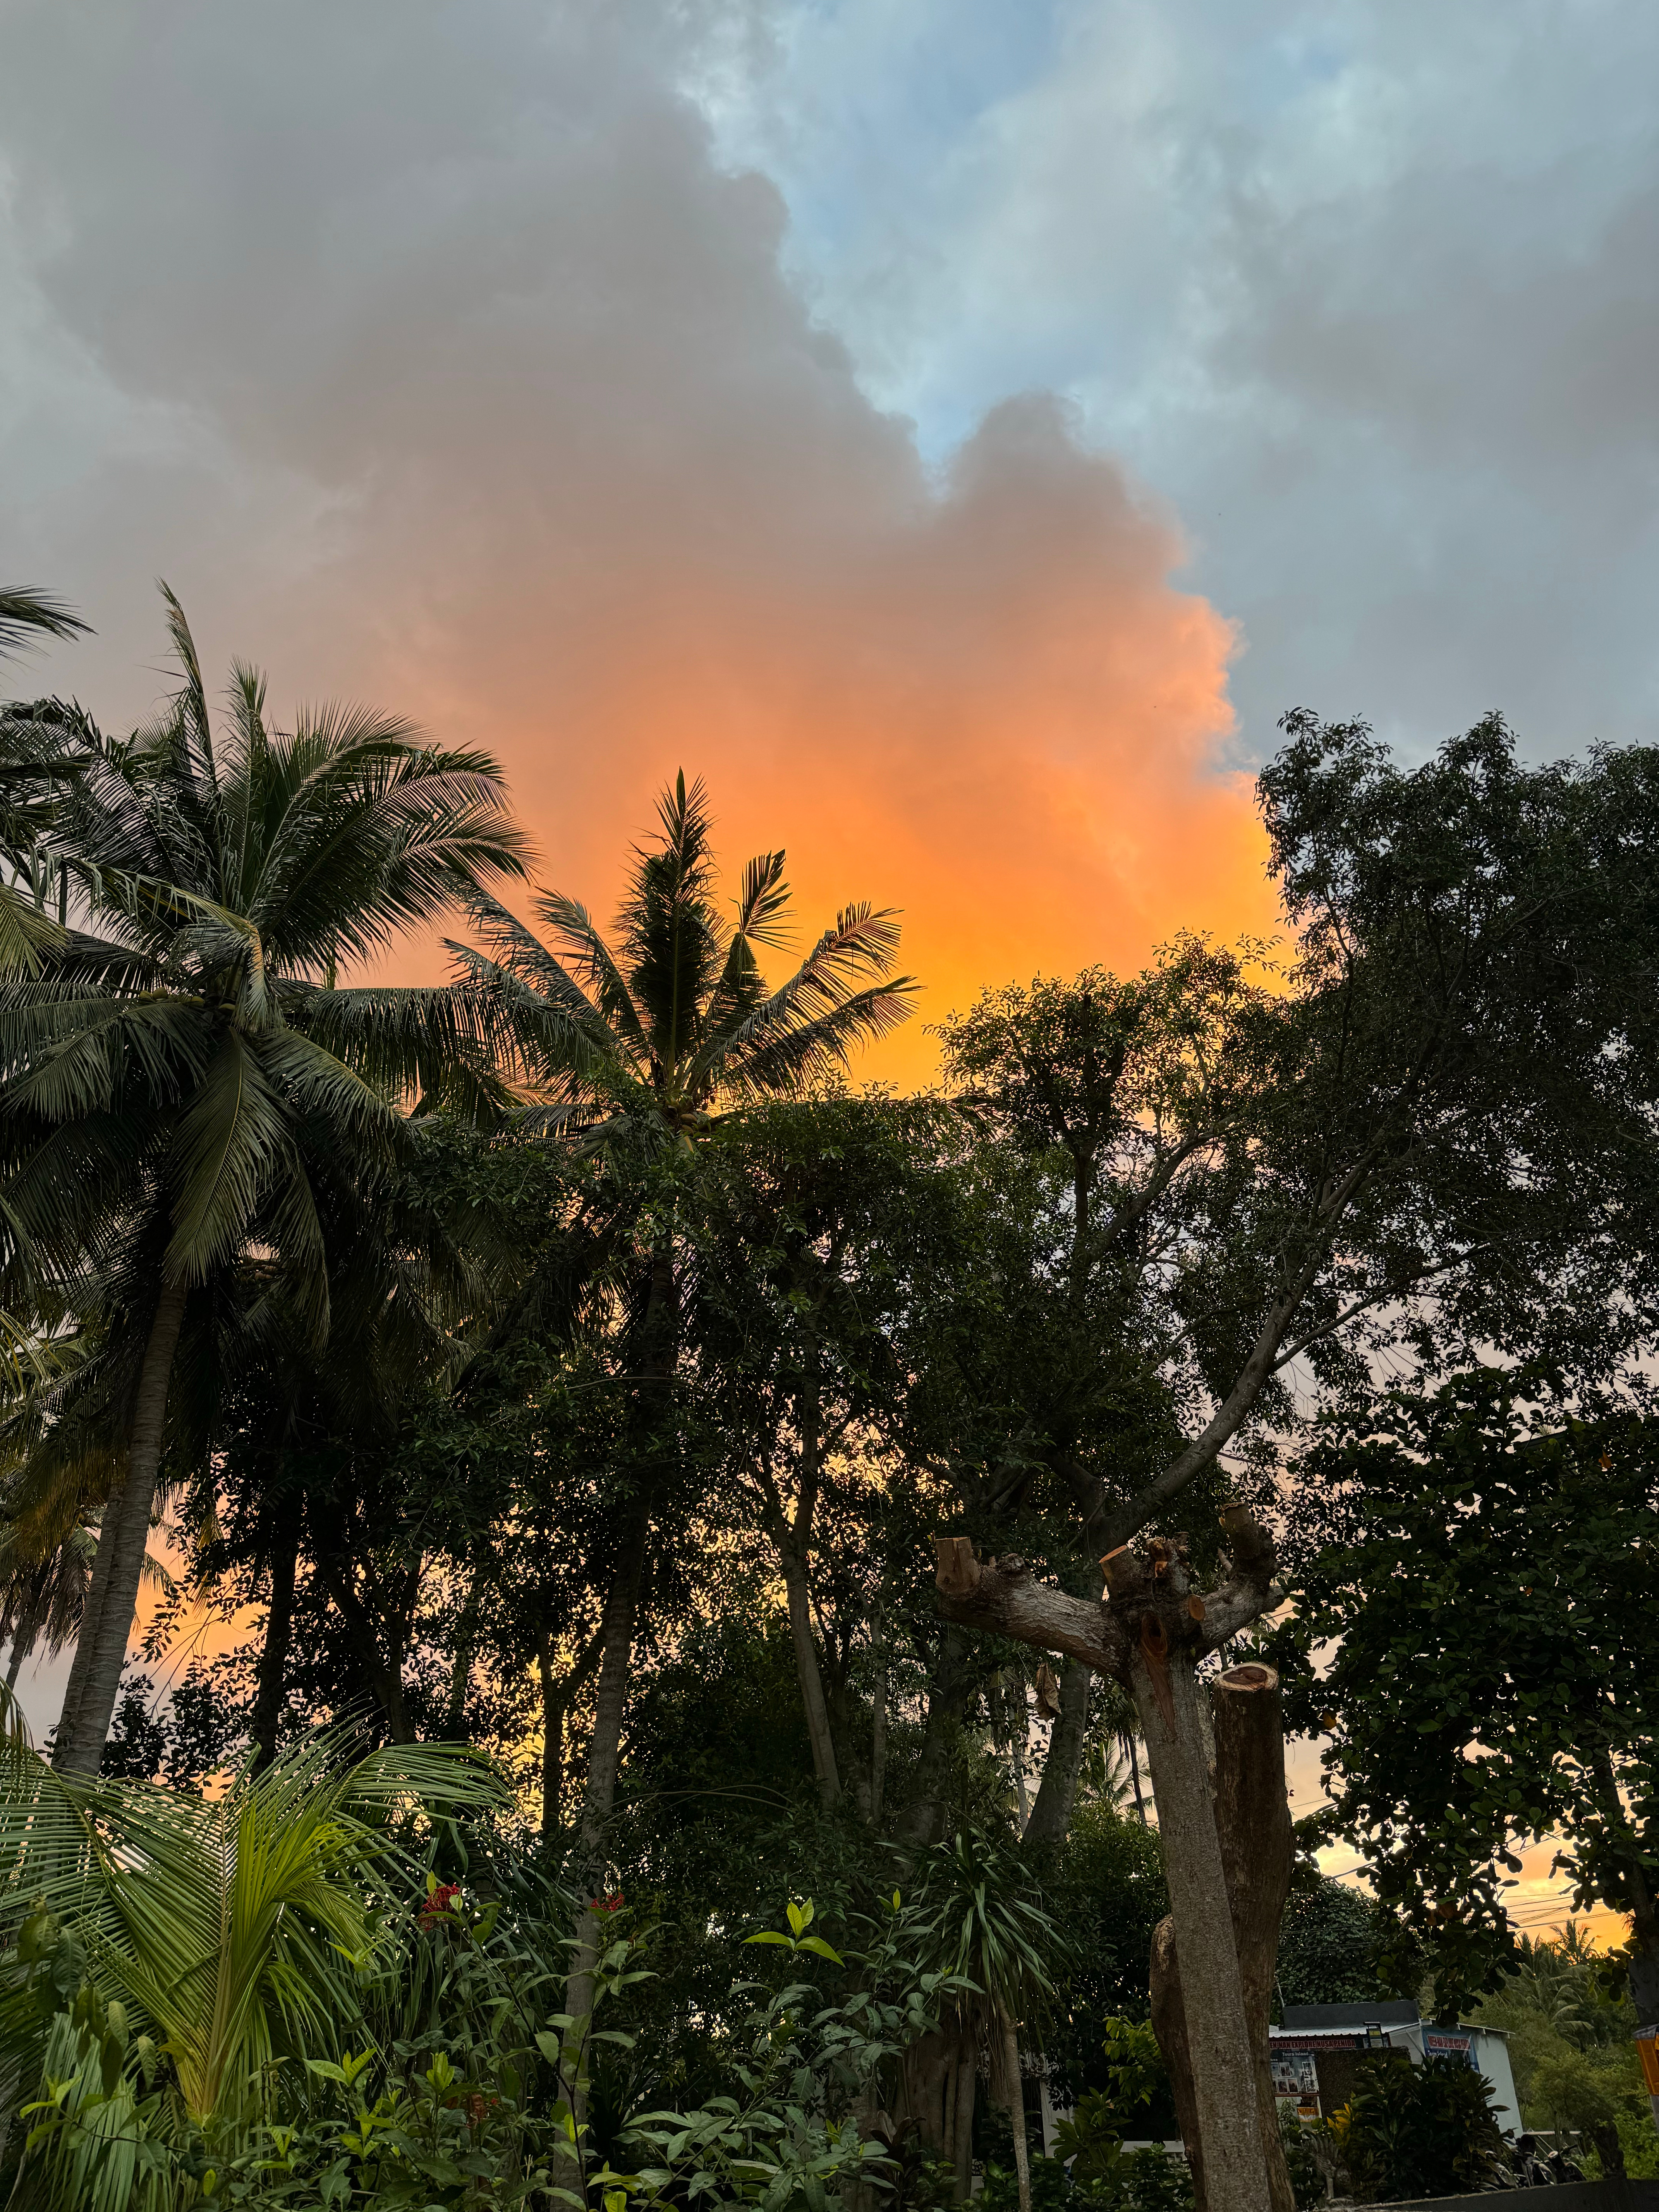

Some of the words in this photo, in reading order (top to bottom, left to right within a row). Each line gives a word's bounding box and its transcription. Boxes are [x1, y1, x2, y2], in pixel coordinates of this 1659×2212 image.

[1291, 2041, 1316, 2049] EXPLORE
[1316, 2040, 1333, 2048] NUSA
[1334, 2039, 1356, 2047] PENIDA
